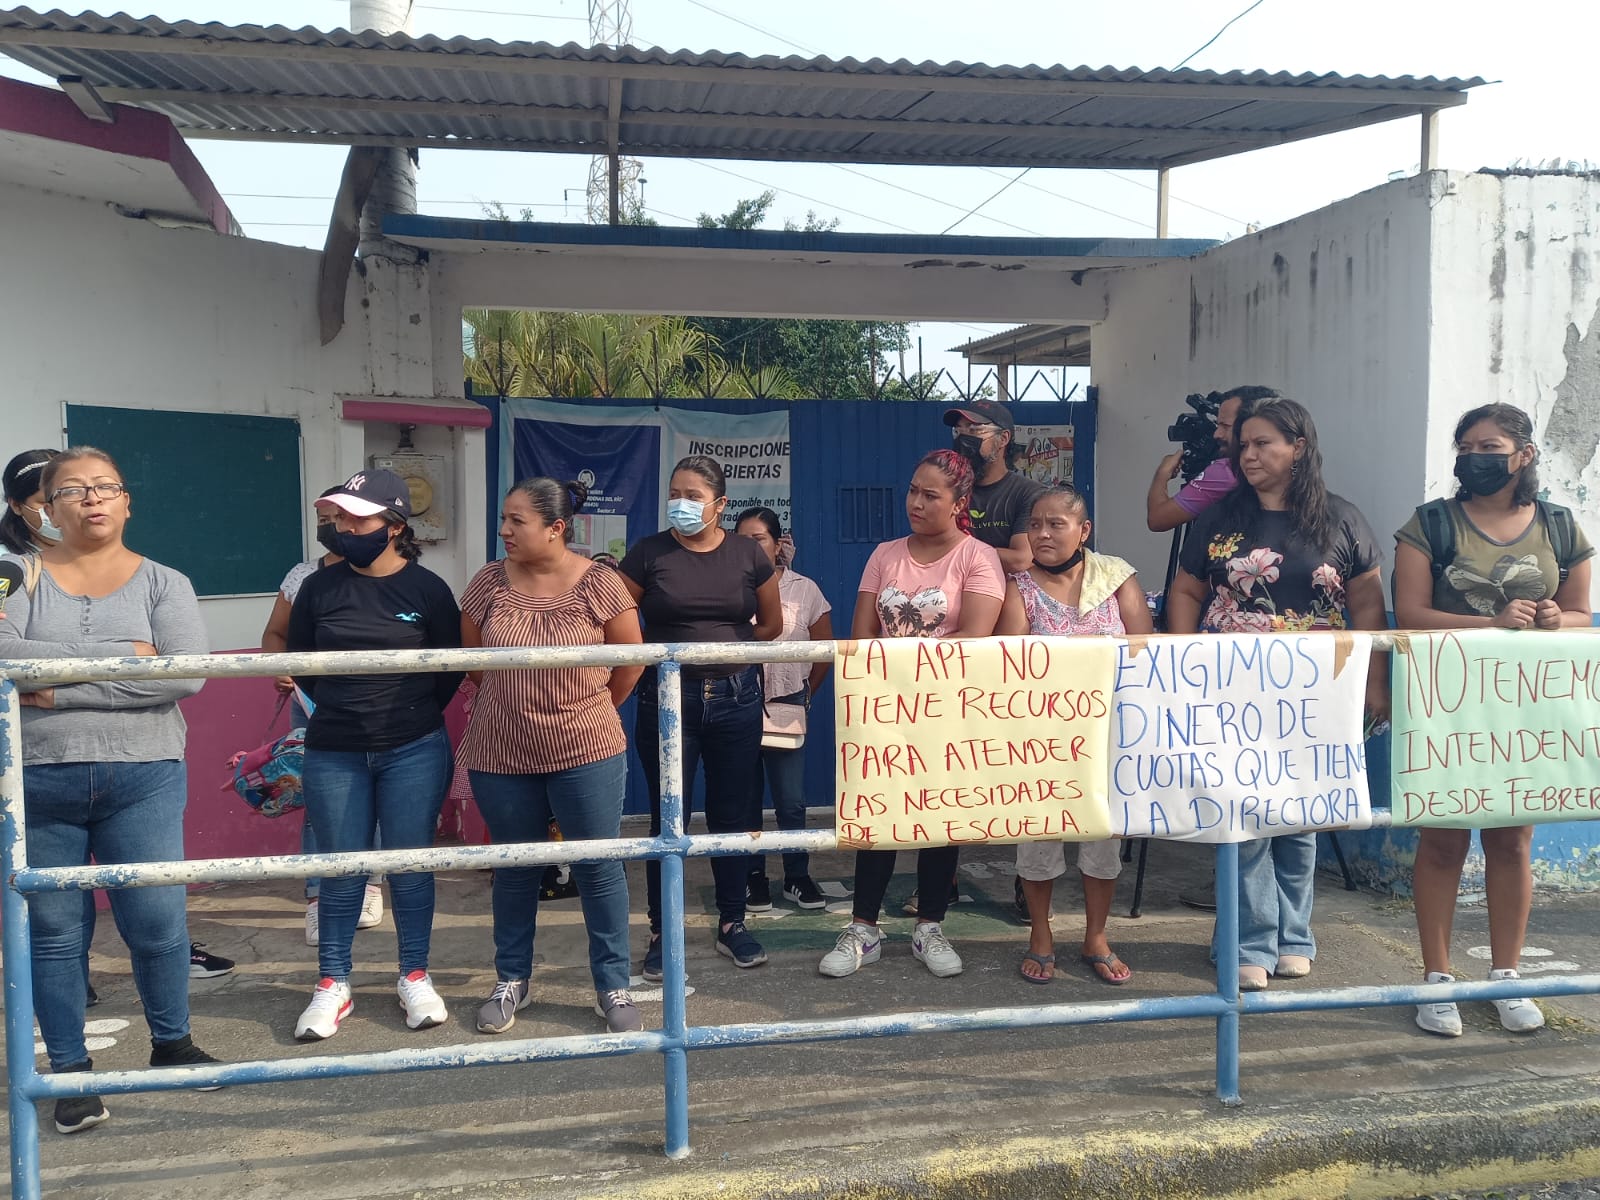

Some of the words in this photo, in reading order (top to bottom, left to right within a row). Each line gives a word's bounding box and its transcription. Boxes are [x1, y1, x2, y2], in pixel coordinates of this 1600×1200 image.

[723, 464, 782, 479] BIERTAS
[727, 496, 761, 510] sponible
[842, 639, 888, 681] LA
[915, 640, 976, 682] APF
[999, 638, 1050, 684] NO
[1114, 637, 1319, 699] EXIGIMOS
[1407, 632, 1467, 720] NO
[840, 692, 943, 728] TIENE
[958, 686, 1107, 722] RECURSOS
[1117, 701, 1263, 750] DINERO
[1276, 698, 1319, 739] DE
[840, 741, 928, 783] PARA
[944, 735, 1092, 771] ATENDER
[1114, 751, 1224, 796] CUOTAS
[1235, 748, 1300, 790] QUE
[839, 791, 888, 821] LAS
[904, 779, 1083, 815] NECESIDADES
[1123, 800, 1171, 836] LA
[1188, 788, 1361, 832] DIRECTORA
[1403, 788, 1495, 823] DESDE
[841, 822, 878, 844] DE
[892, 823, 930, 842] LA
[942, 809, 1089, 842] ESCUELA.
